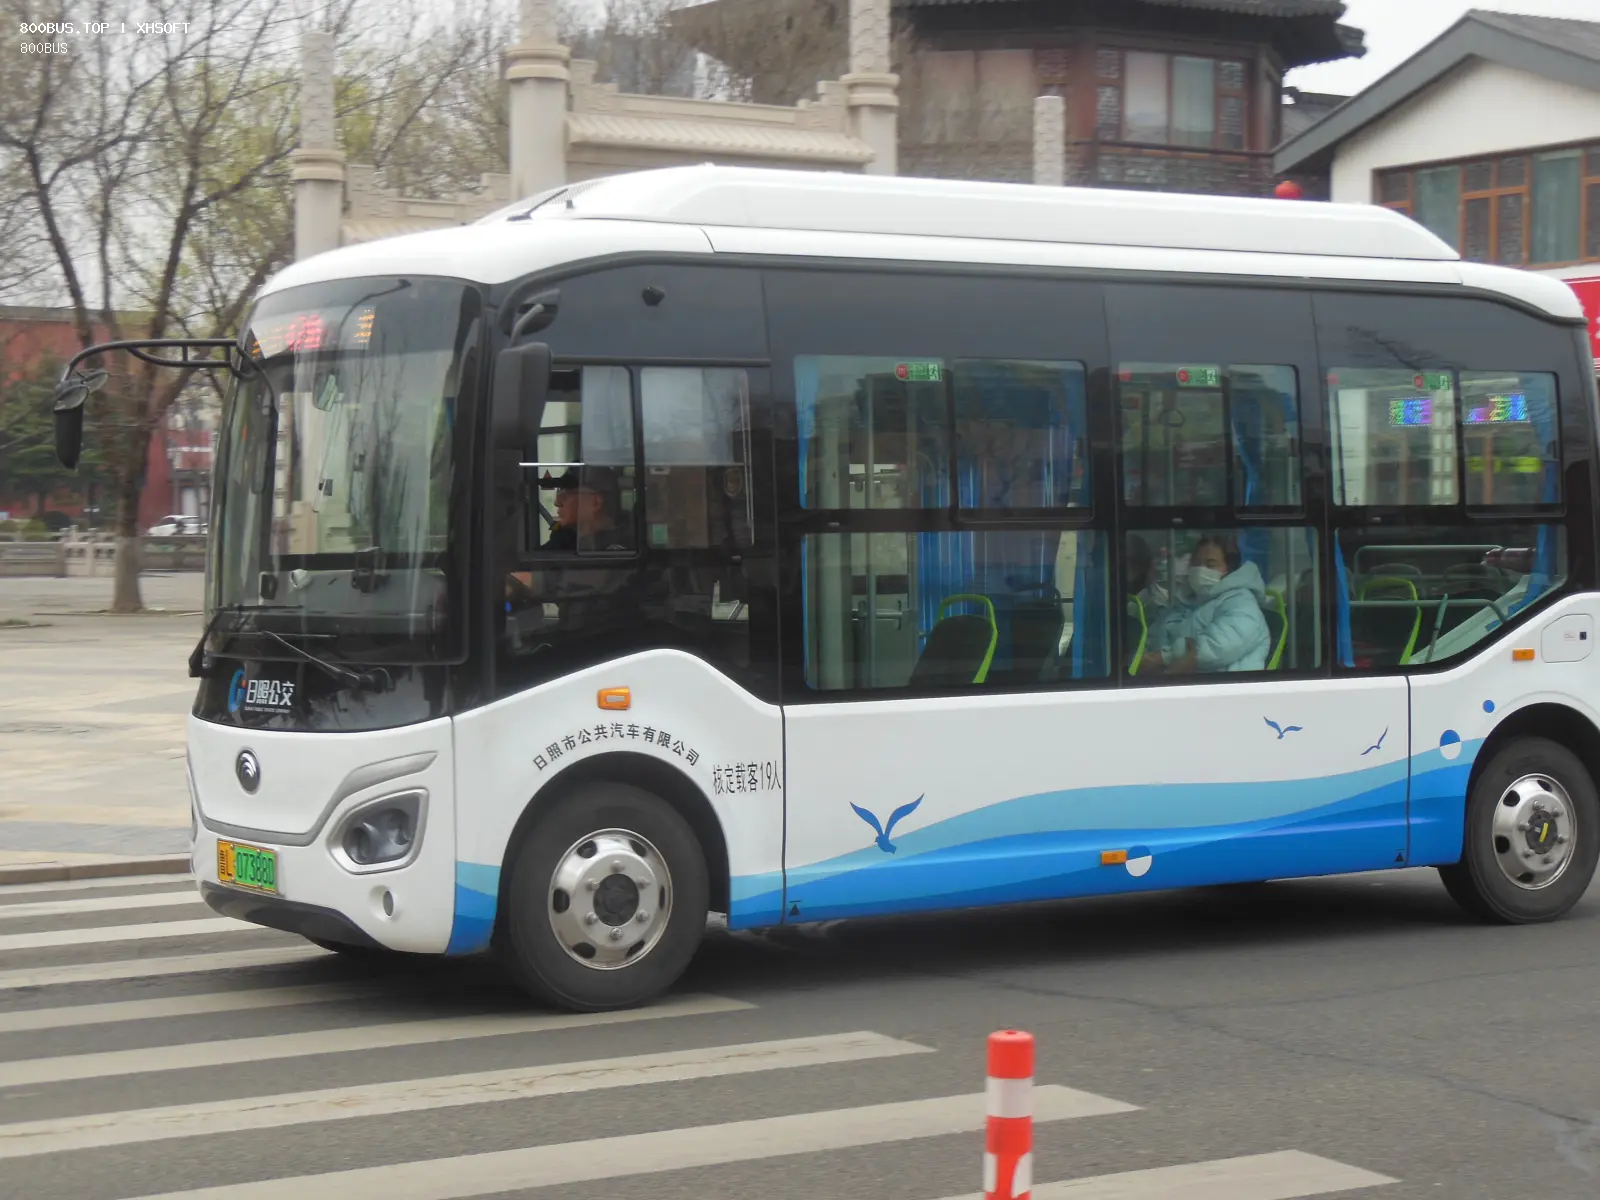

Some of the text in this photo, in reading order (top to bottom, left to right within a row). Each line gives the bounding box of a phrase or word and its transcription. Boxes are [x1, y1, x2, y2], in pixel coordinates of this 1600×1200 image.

[246, 680, 294, 706] 日照公交
[533, 723, 700, 770] 日照市公共汽车有限公司
[713, 761, 781, 795] 核定载客19人
